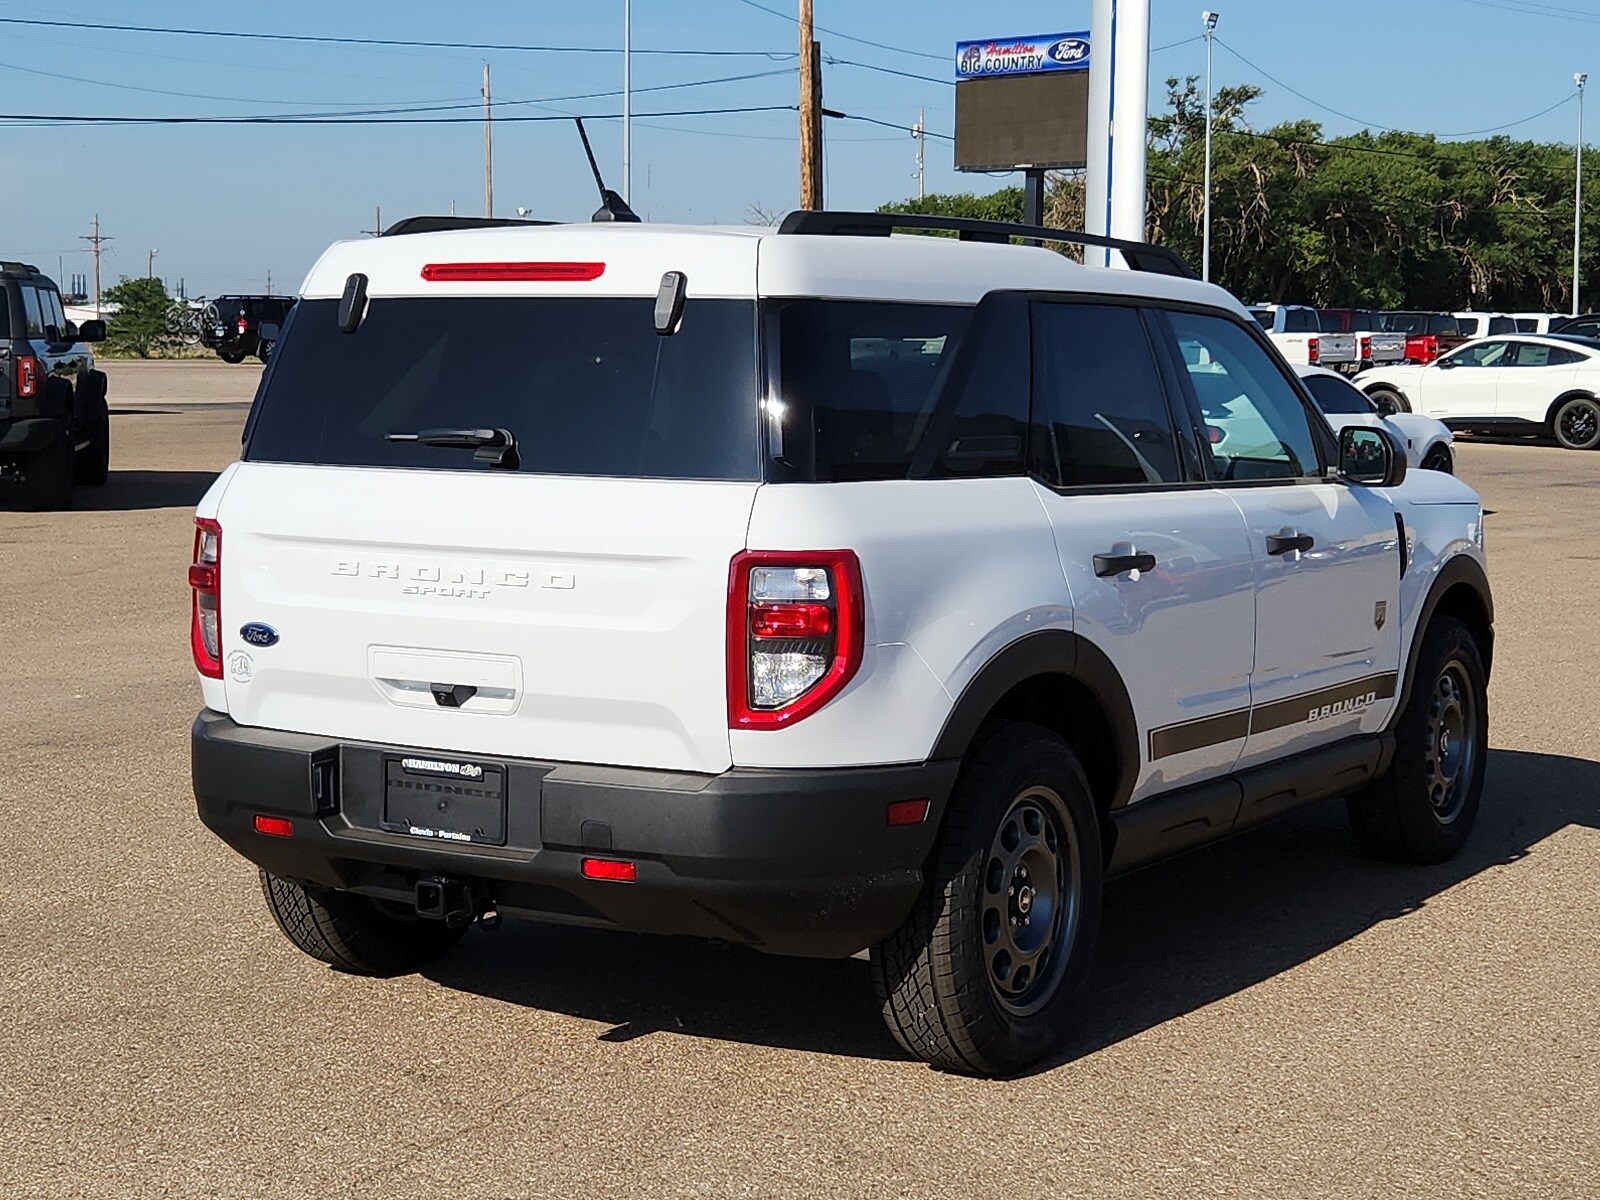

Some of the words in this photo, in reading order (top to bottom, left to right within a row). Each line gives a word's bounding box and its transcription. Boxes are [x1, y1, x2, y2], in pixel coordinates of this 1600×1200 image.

[1055, 41, 1086, 60] Ford
[961, 58, 981, 74] BIG
[985, 54, 1044, 72] COUNTRY
[330, 559, 577, 591] BRONCO
[402, 582, 492, 600] SPORT
[246, 626, 270, 644] Ford
[1307, 691, 1377, 722] BRONCO
[408, 758, 460, 773] HAMILTON
